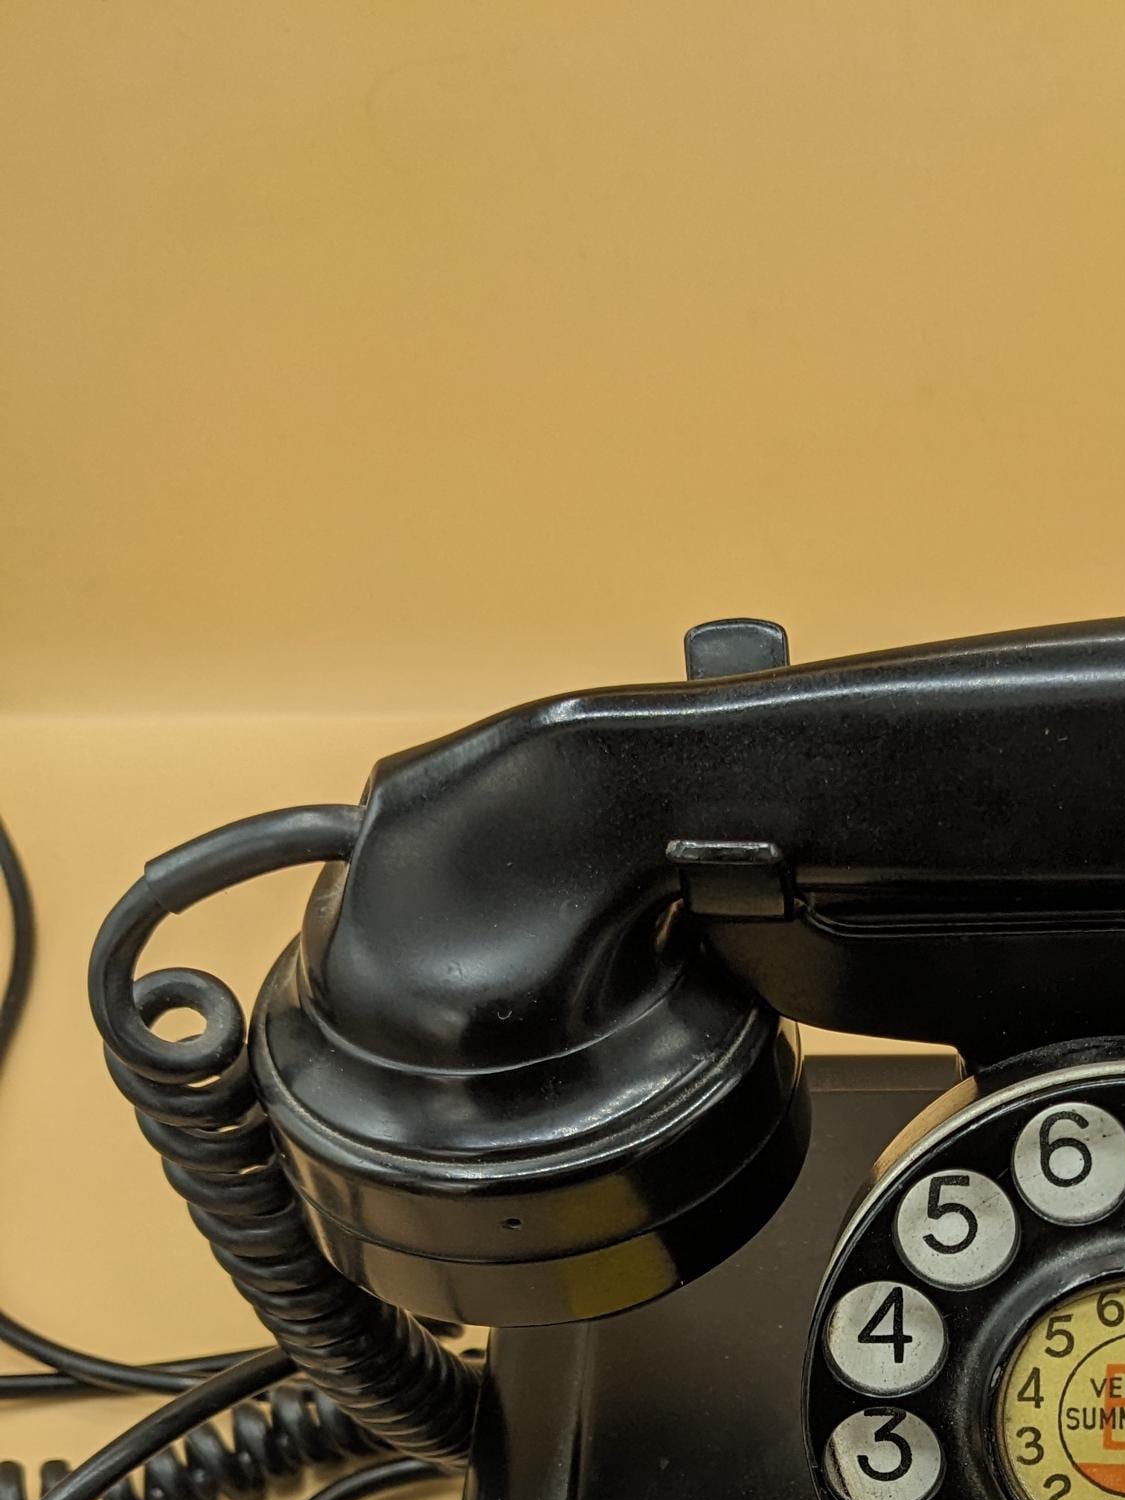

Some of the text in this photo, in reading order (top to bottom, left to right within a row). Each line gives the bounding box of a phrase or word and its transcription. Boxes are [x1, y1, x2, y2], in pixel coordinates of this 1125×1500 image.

[1039, 1111, 1092, 1187] 6
[922, 1175, 978, 1254] 5
[858, 1286, 913, 1363] 4
[1044, 1313, 1074, 1358] 5
[1097, 1290, 1124, 1327] 6
[1016, 1367, 1044, 1409] 4
[858, 1408, 913, 1480] 3
[1016, 1426, 1044, 1465] 3
